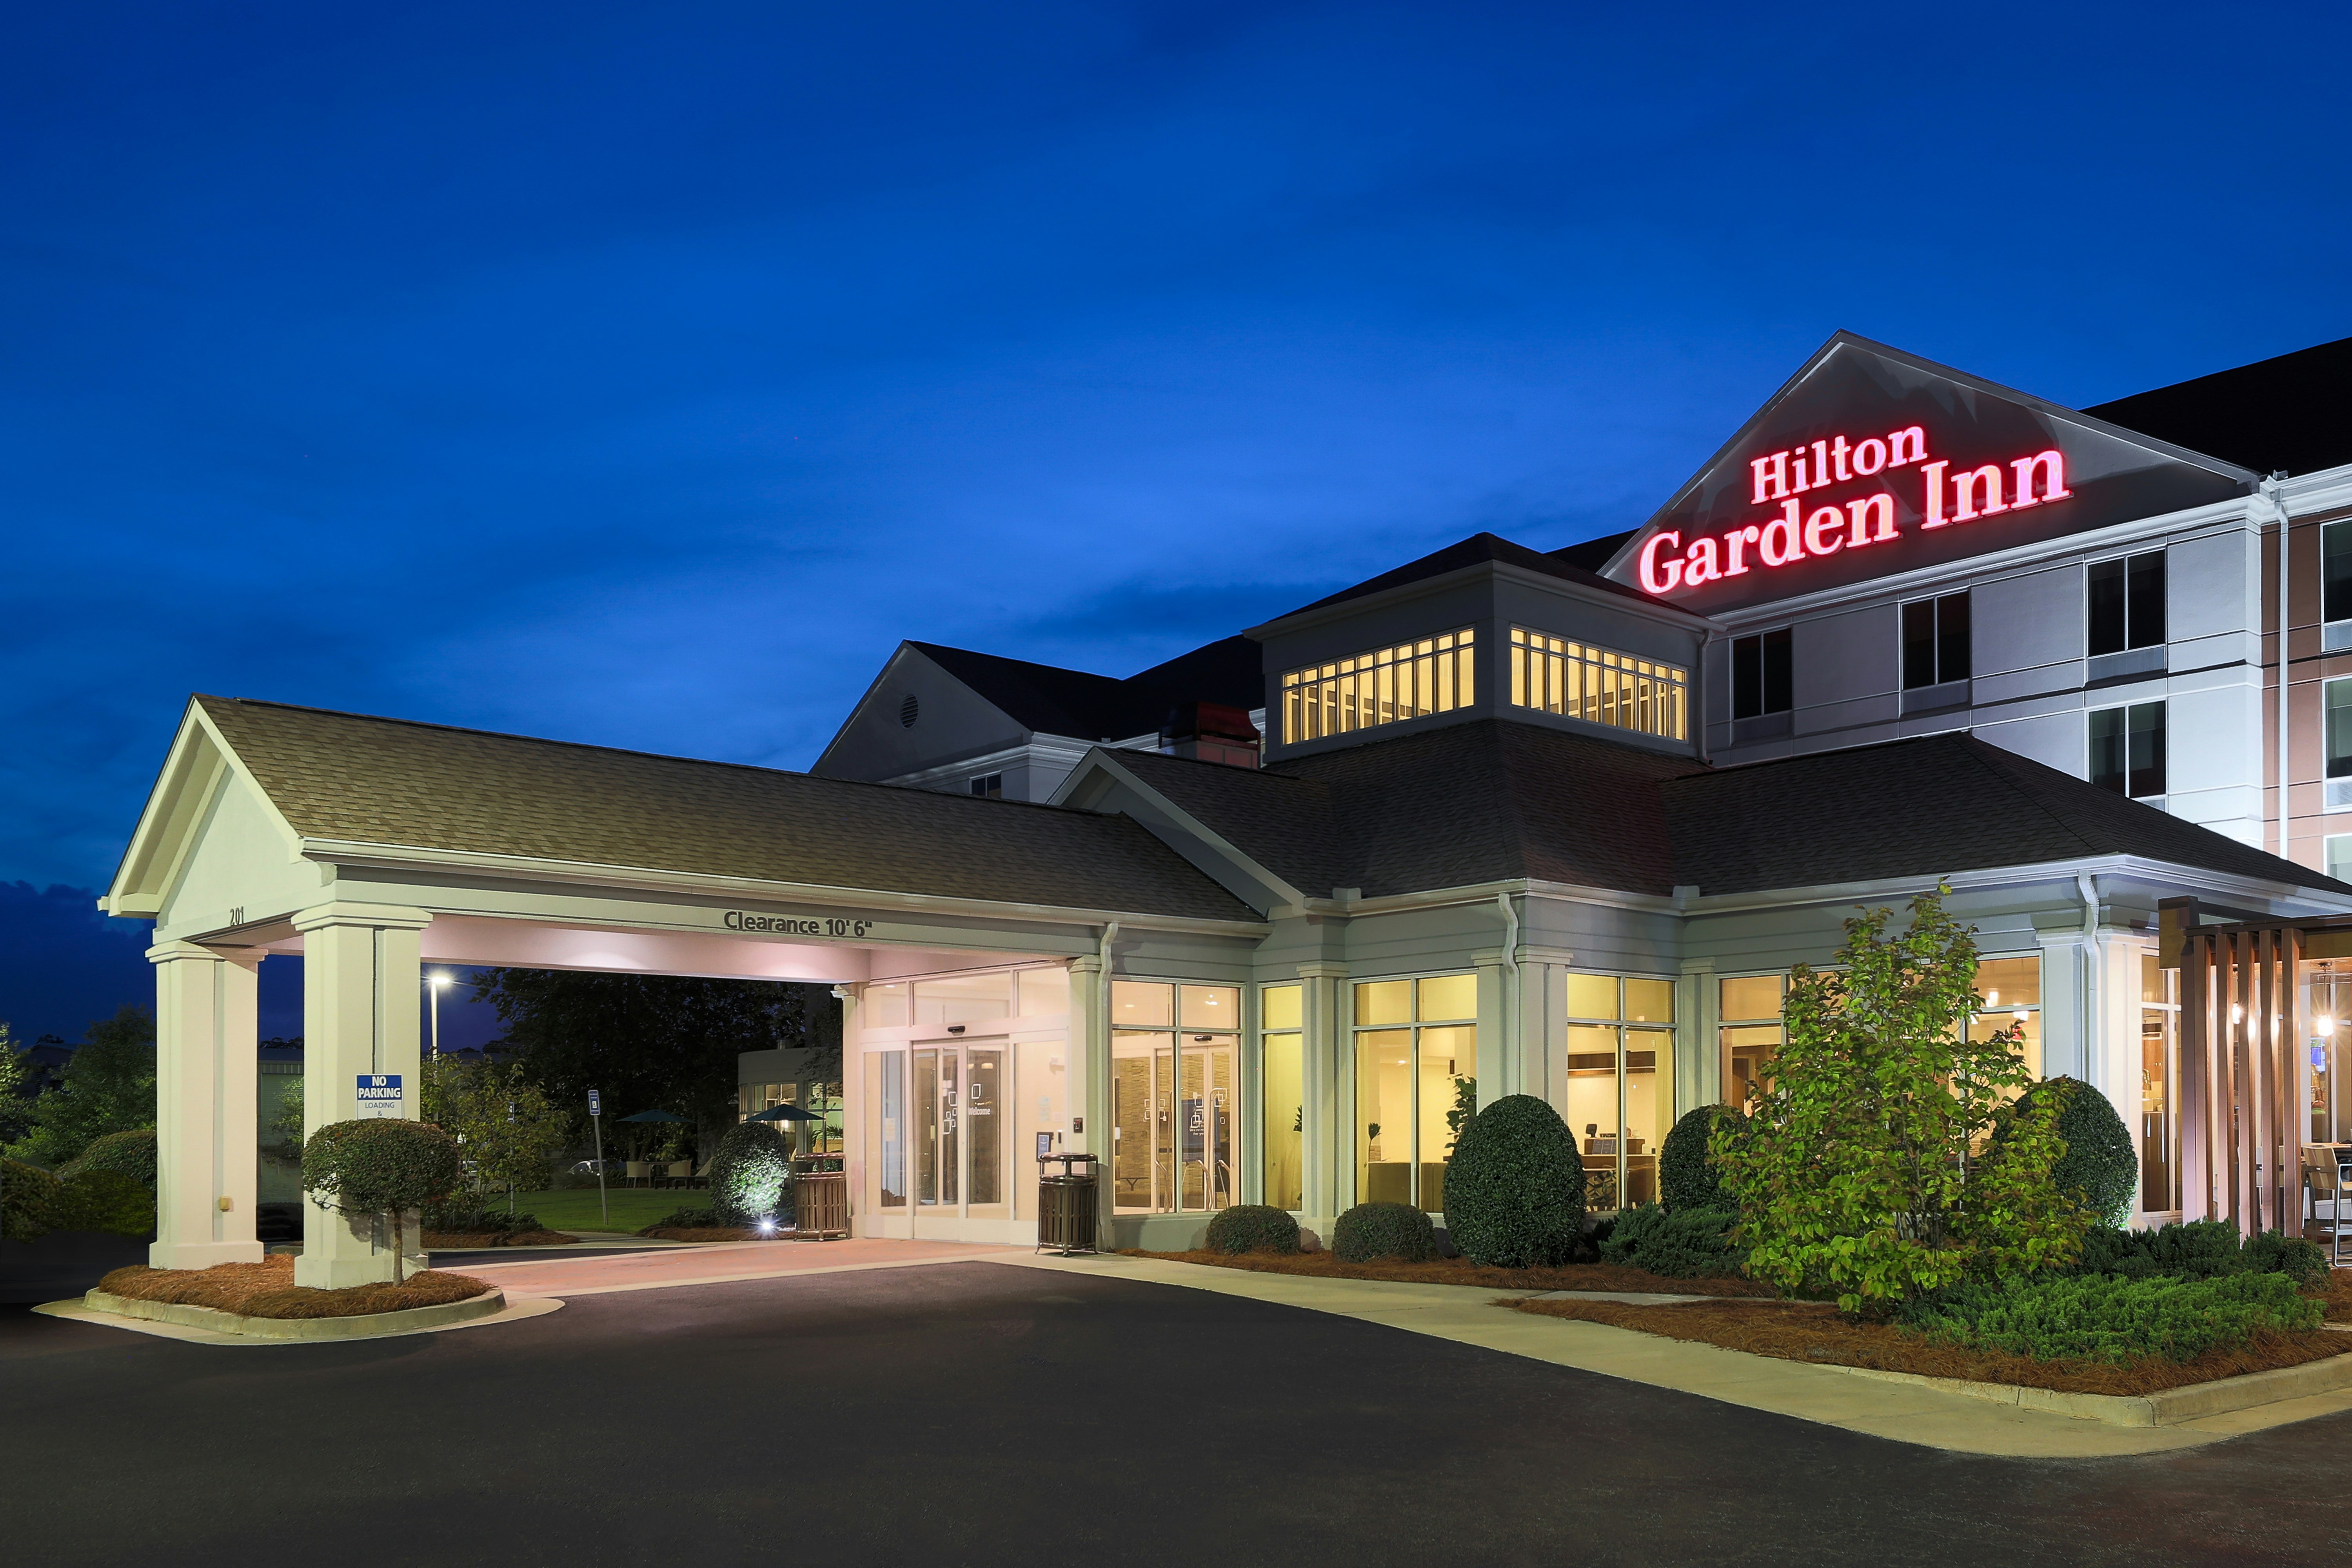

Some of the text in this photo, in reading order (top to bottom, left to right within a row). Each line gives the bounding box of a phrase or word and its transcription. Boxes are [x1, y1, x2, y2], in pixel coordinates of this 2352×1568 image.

[1750, 426, 1928, 505] Hilton
[1639, 450, 2071, 594] Garden Inn
[230, 906, 243, 926] 201
[724, 911, 873, 937] Clearance 10' 6"
[372, 1076, 387, 1086] NO
[358, 1087, 401, 1098] PARKING
[968, 1107, 991, 1115] Welcome
